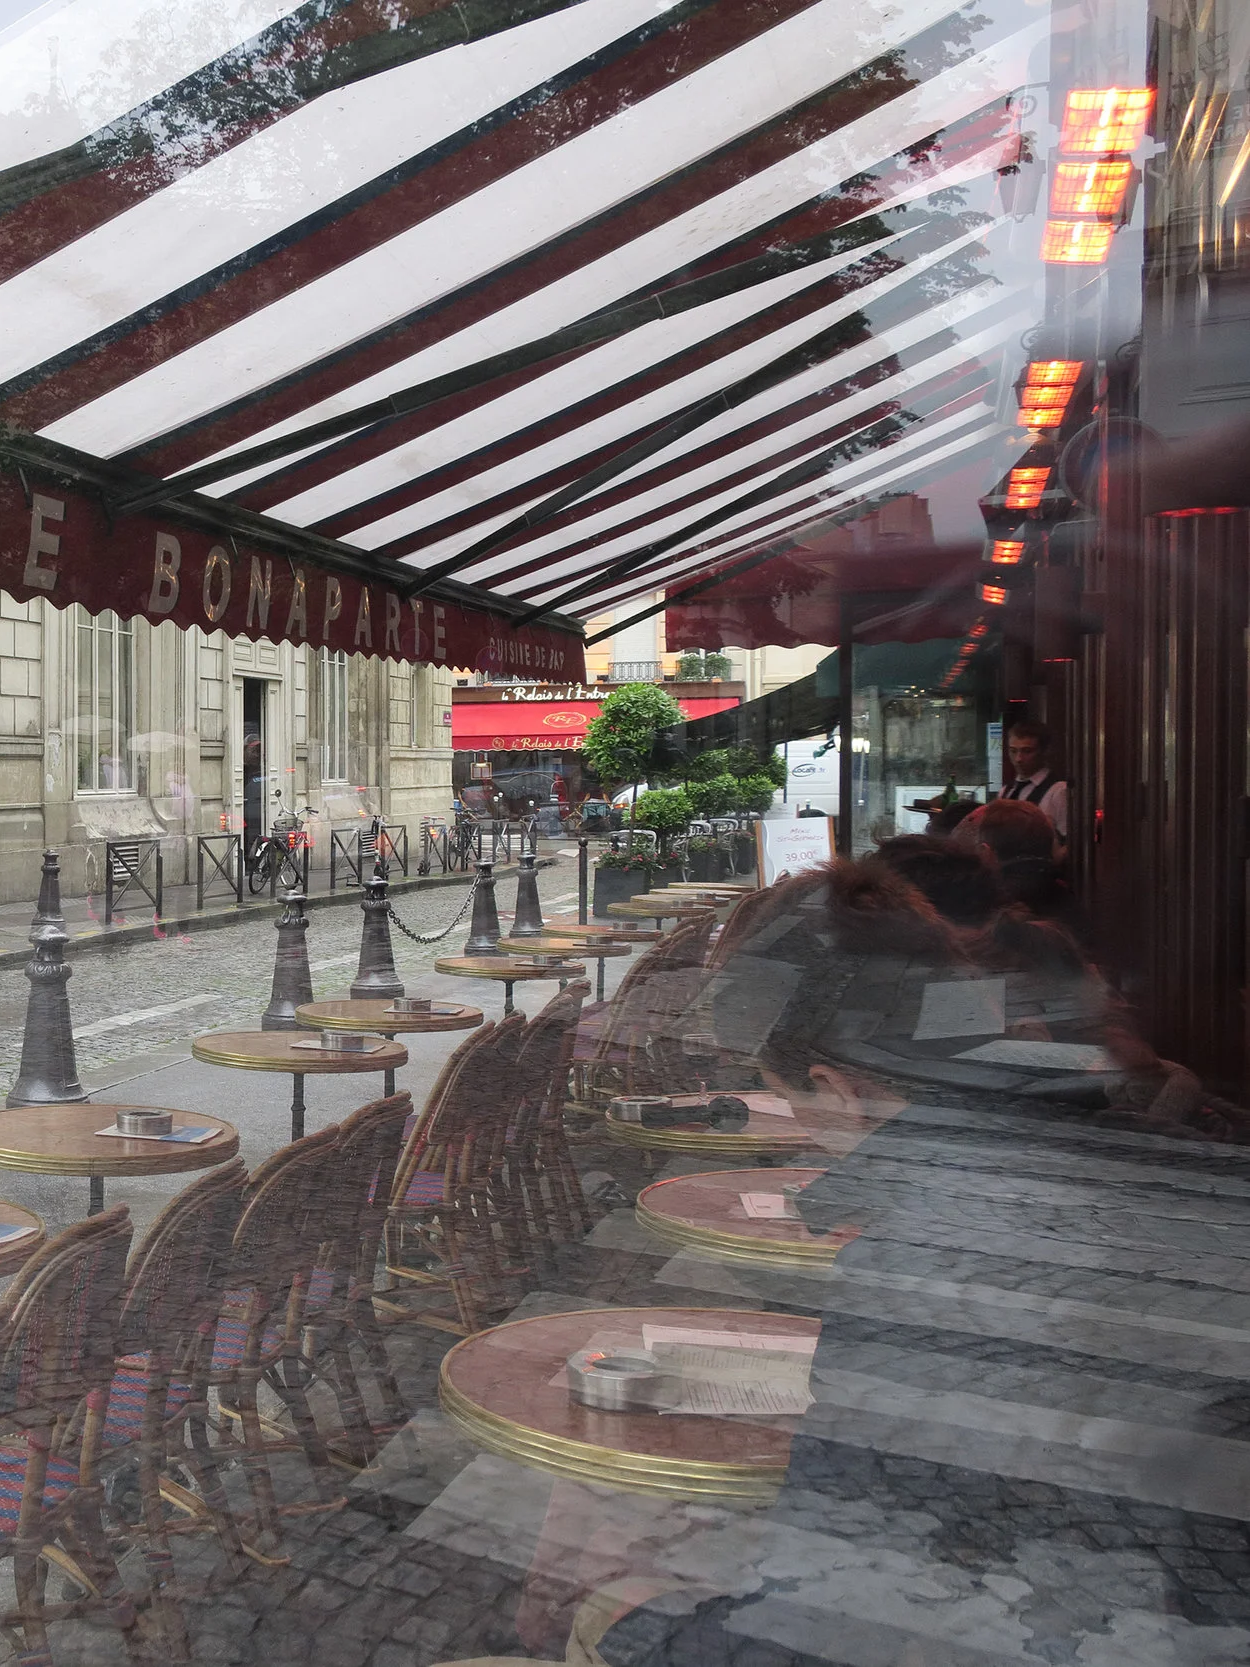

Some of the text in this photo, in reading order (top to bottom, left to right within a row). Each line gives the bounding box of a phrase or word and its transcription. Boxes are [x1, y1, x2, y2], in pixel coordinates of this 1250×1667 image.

[148, 531, 447, 660] BONAPARTE
[535, 645, 546, 667] DE
[512, 686, 553, 701] Relais
[552, 690, 563, 701] de
[520, 736, 553, 749] Relais
